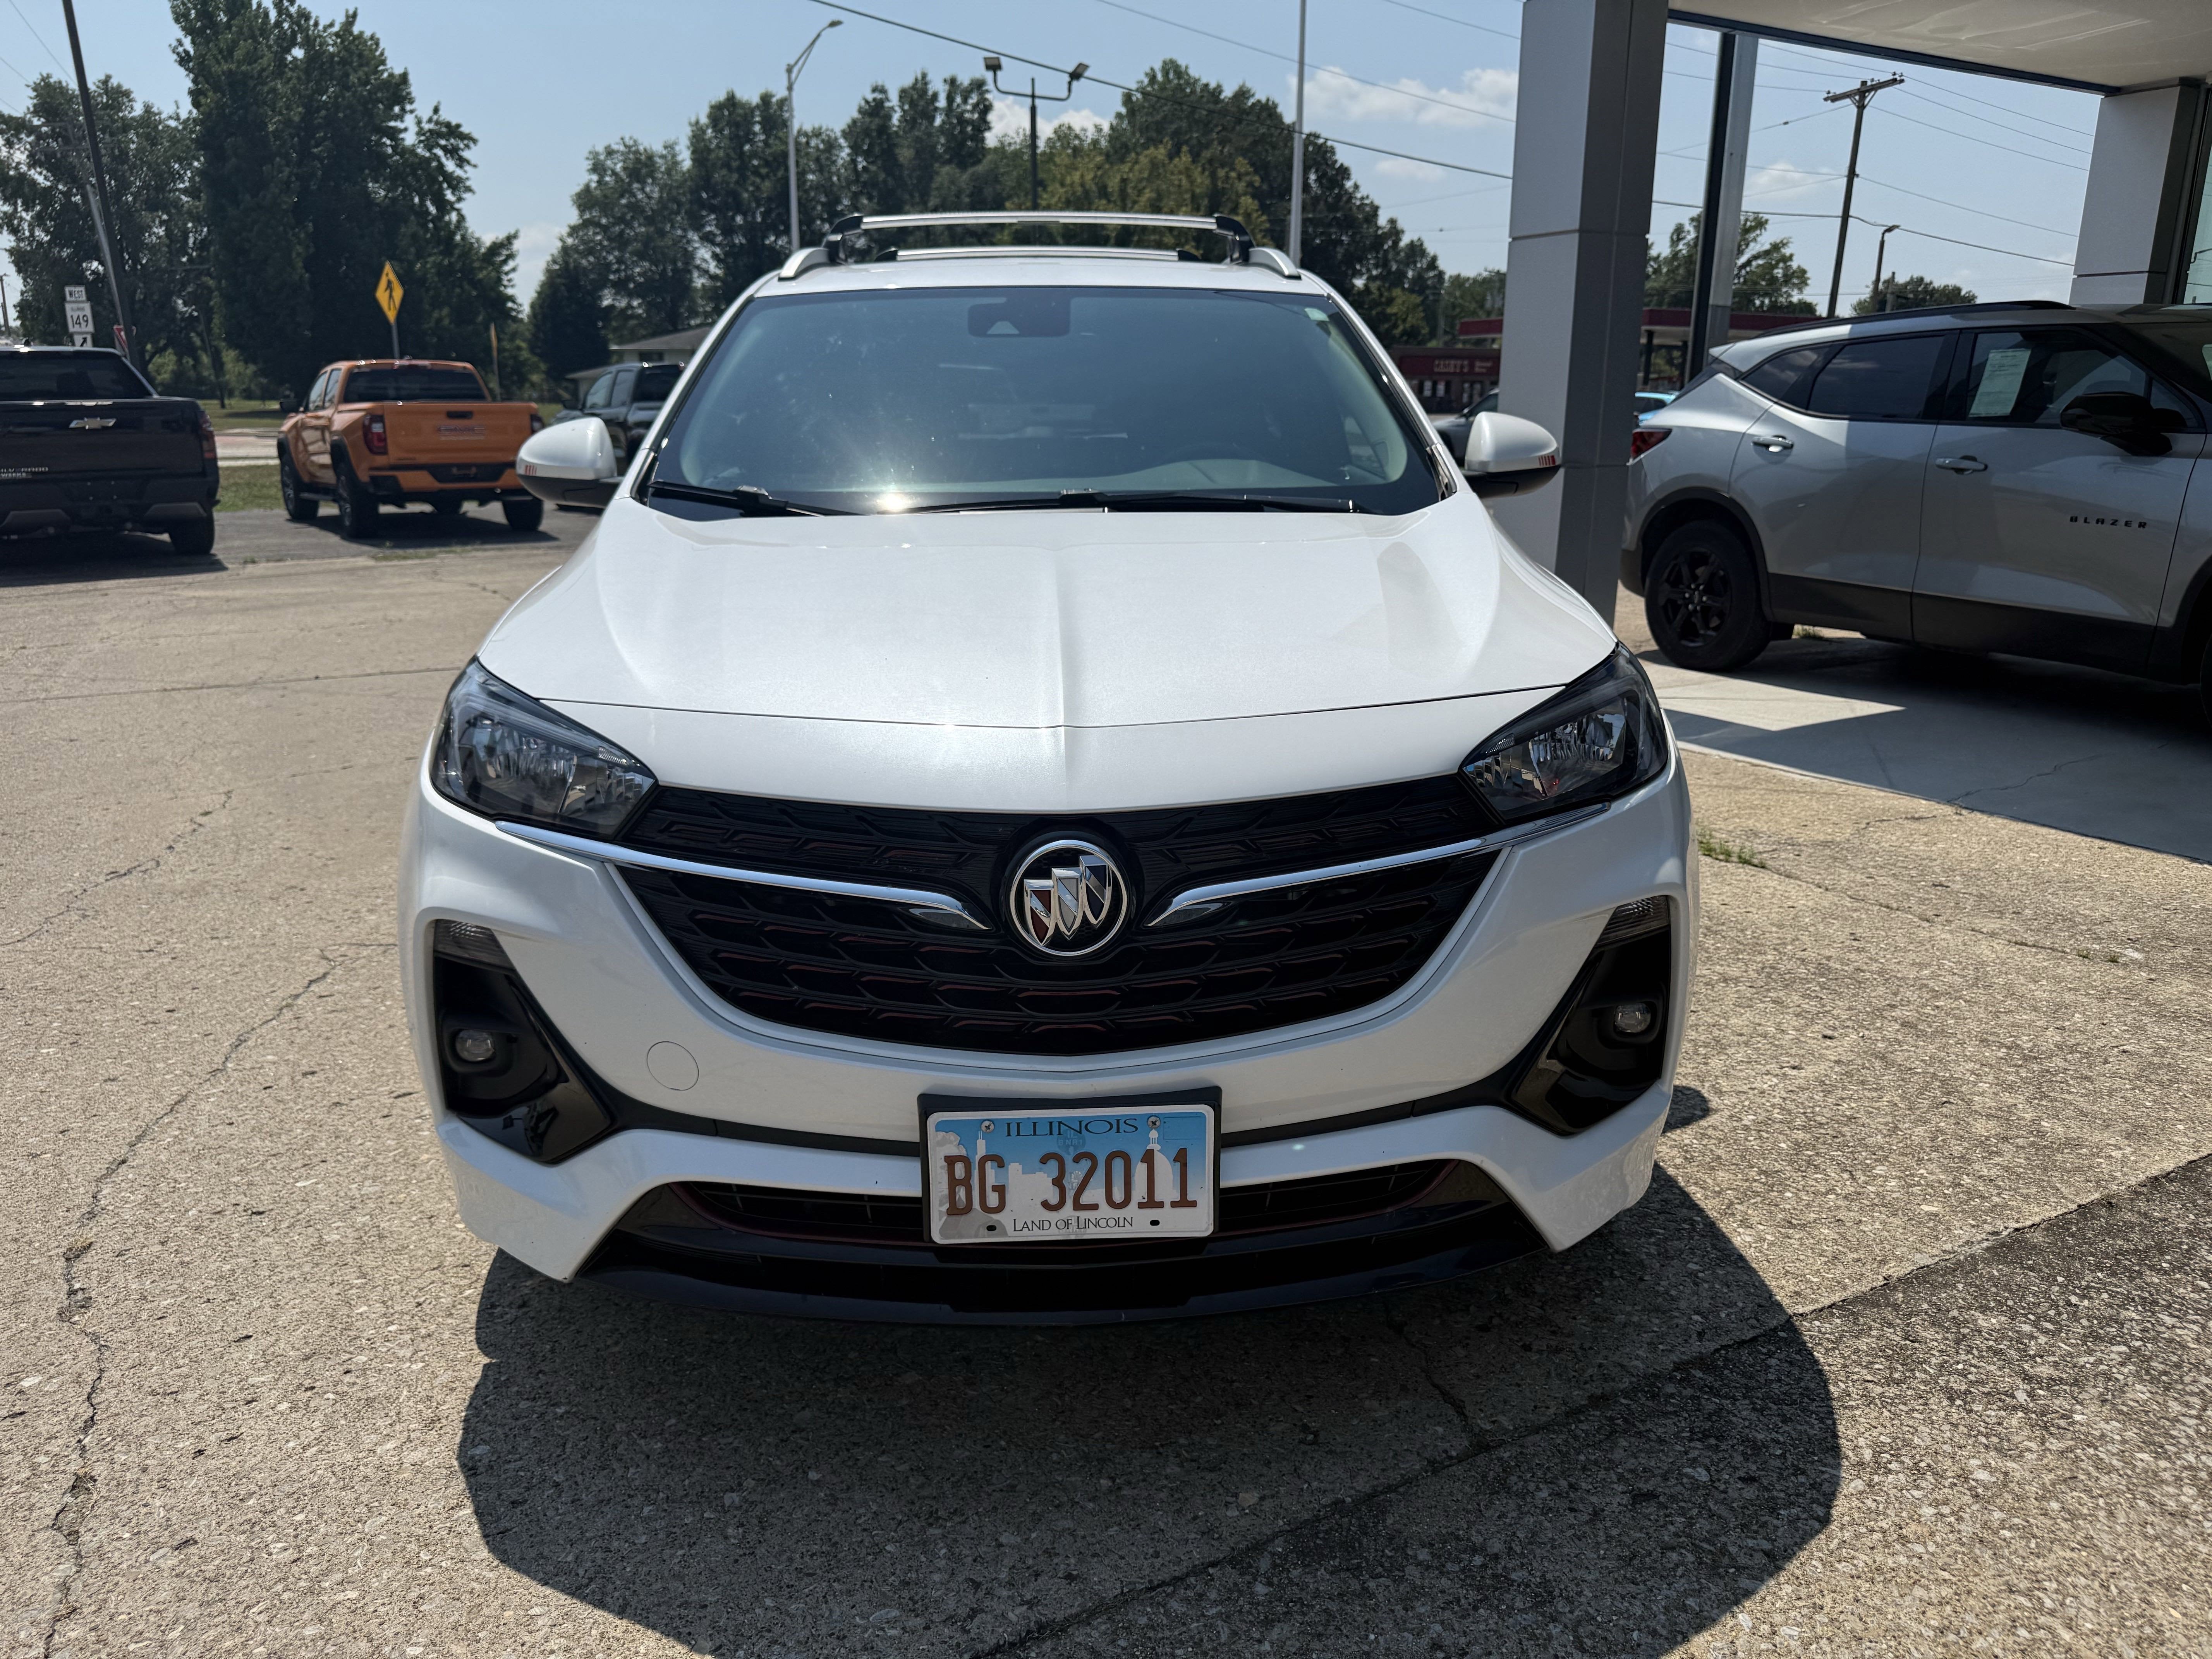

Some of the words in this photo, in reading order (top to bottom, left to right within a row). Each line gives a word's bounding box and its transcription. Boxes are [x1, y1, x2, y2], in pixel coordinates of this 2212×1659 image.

[68, 289, 83, 299] WEST
[70, 314, 89, 328] 149
[2069, 516, 2147, 529] BLAZER
[1005, 1118, 1139, 1137] ILLINOIS
[944, 1154, 1006, 1216] BG
[1039, 1147, 1197, 1212] 32011
[1013, 1218, 1052, 1232] LAND
[1055, 1219, 1073, 1230] OF
[1077, 1216, 1133, 1229] LINCOLN
